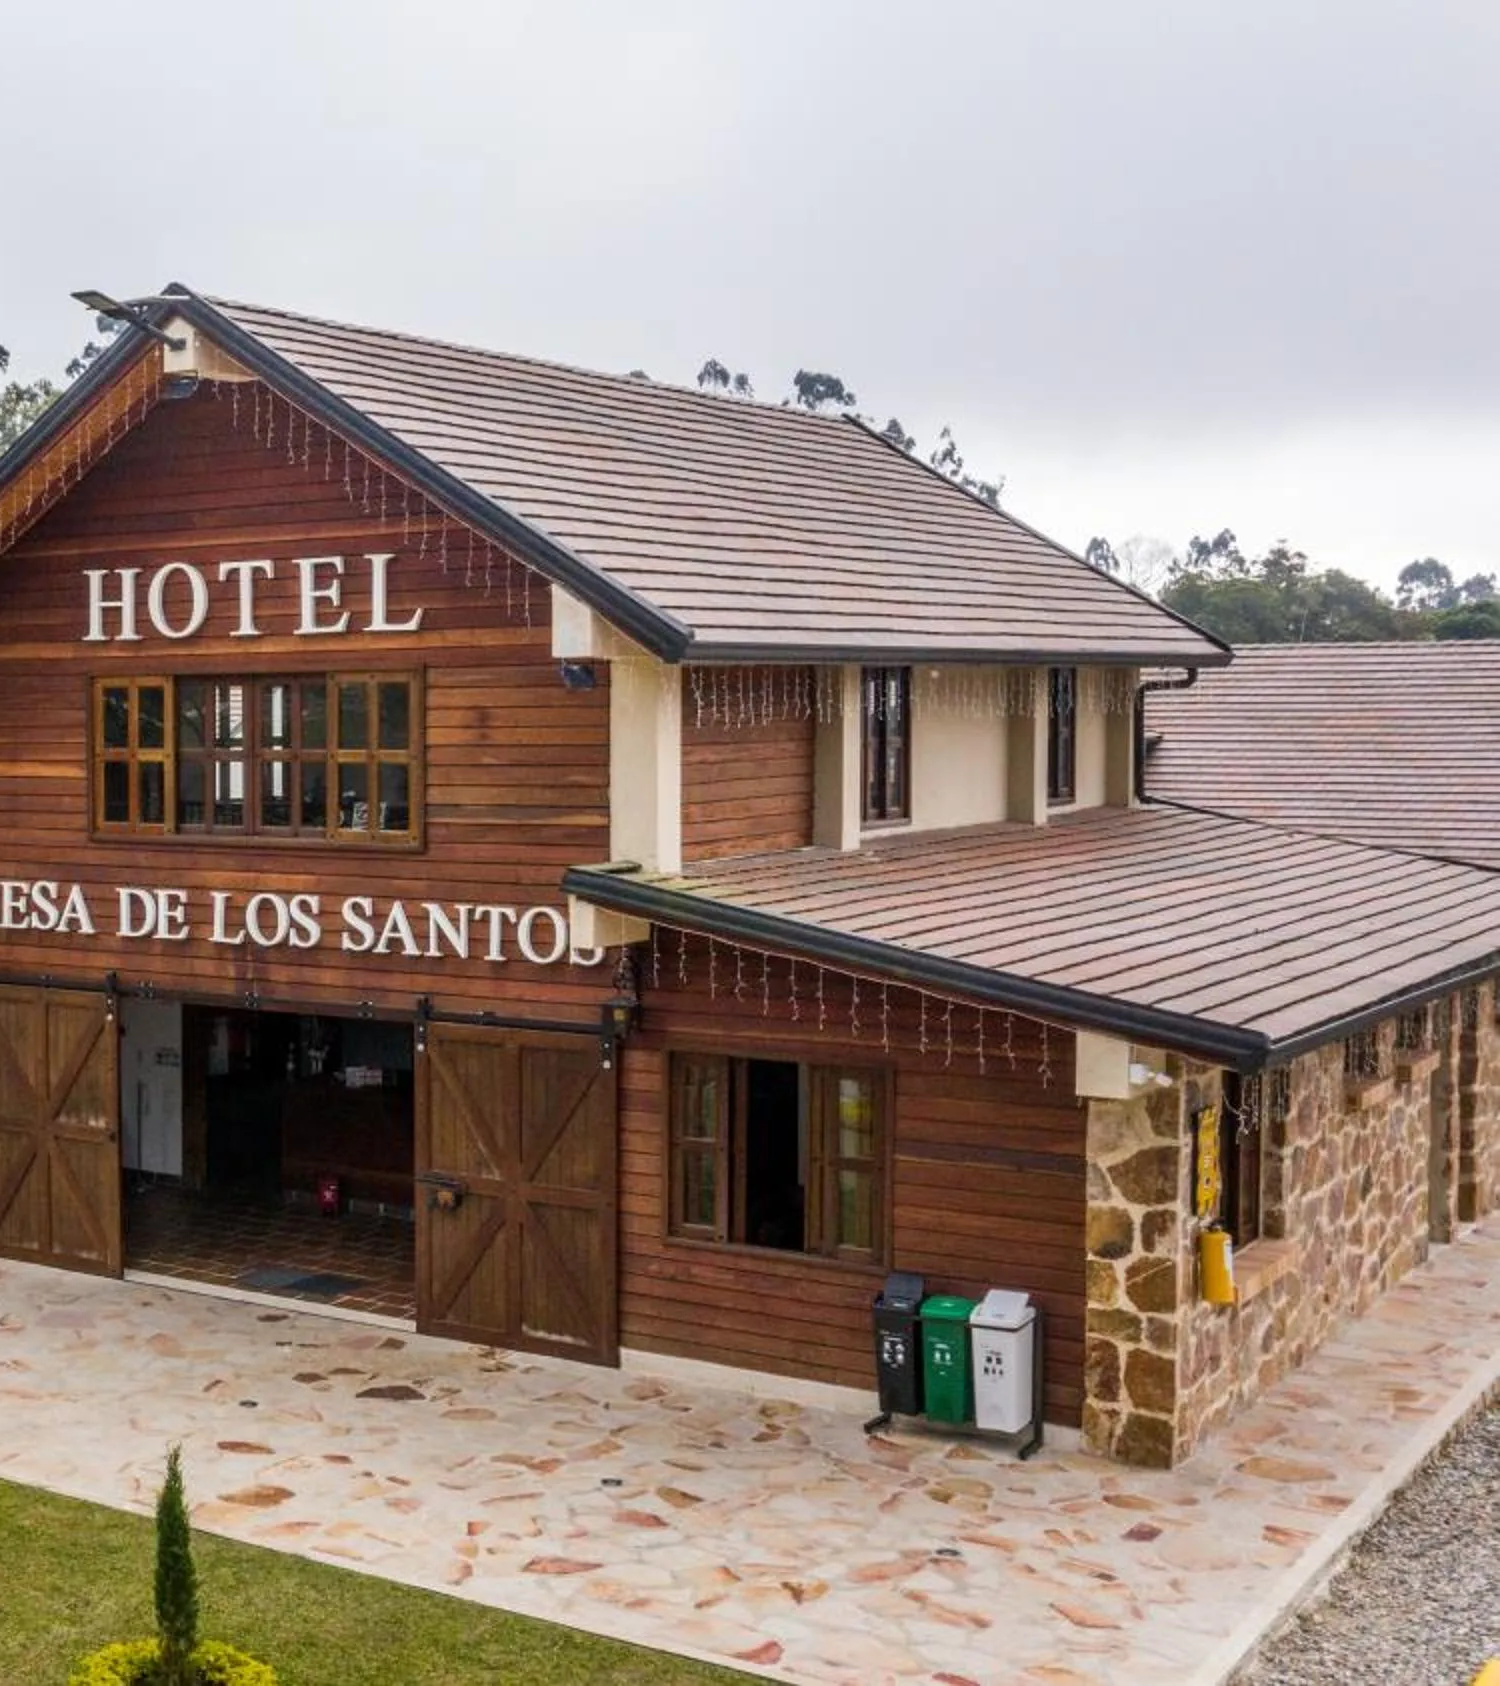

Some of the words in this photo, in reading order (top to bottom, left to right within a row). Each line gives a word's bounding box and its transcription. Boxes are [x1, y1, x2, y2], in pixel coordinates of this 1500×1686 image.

[81, 553, 423, 641] HOTEL
[115, 887, 190, 940] DE
[208, 890, 322, 949] LOS
